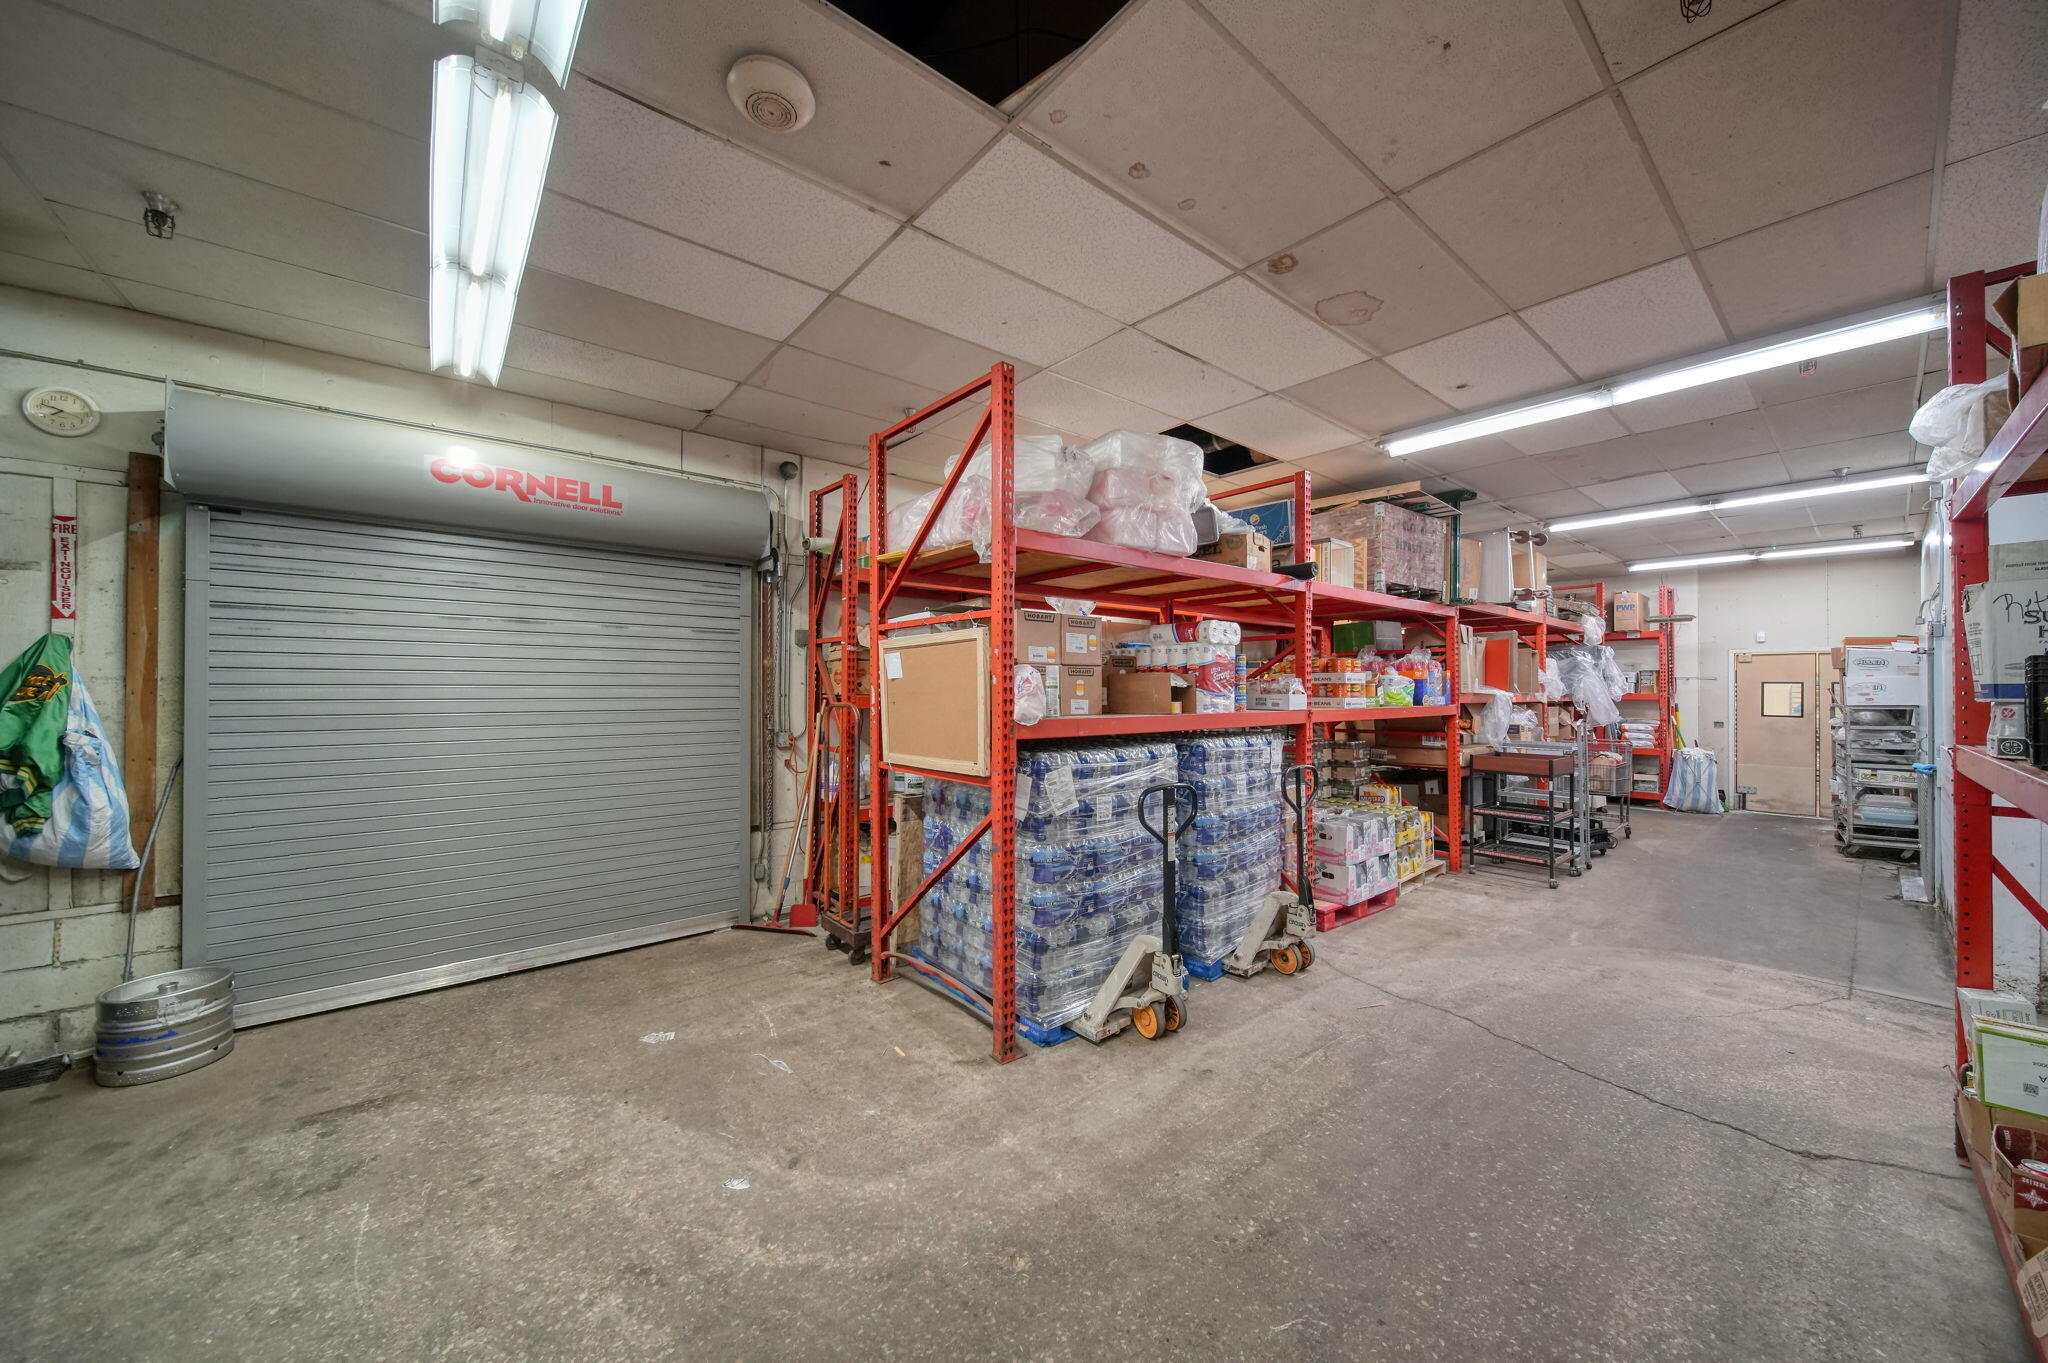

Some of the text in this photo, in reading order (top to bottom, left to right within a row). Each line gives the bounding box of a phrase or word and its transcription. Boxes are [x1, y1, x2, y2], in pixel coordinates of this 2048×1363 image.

[430, 458, 623, 508] CORNELL
[533, 497, 571, 509] innovative
[573, 503, 589, 511] door
[52, 523, 78, 535] FIRE
[60, 536, 72, 610] EXTINGUISHER
[1615, 603, 1636, 612] PWP
[1027, 612, 1053, 621] HOBART
[1070, 619, 1094, 627] HOBART
[1212, 670, 1231, 682] Strong
